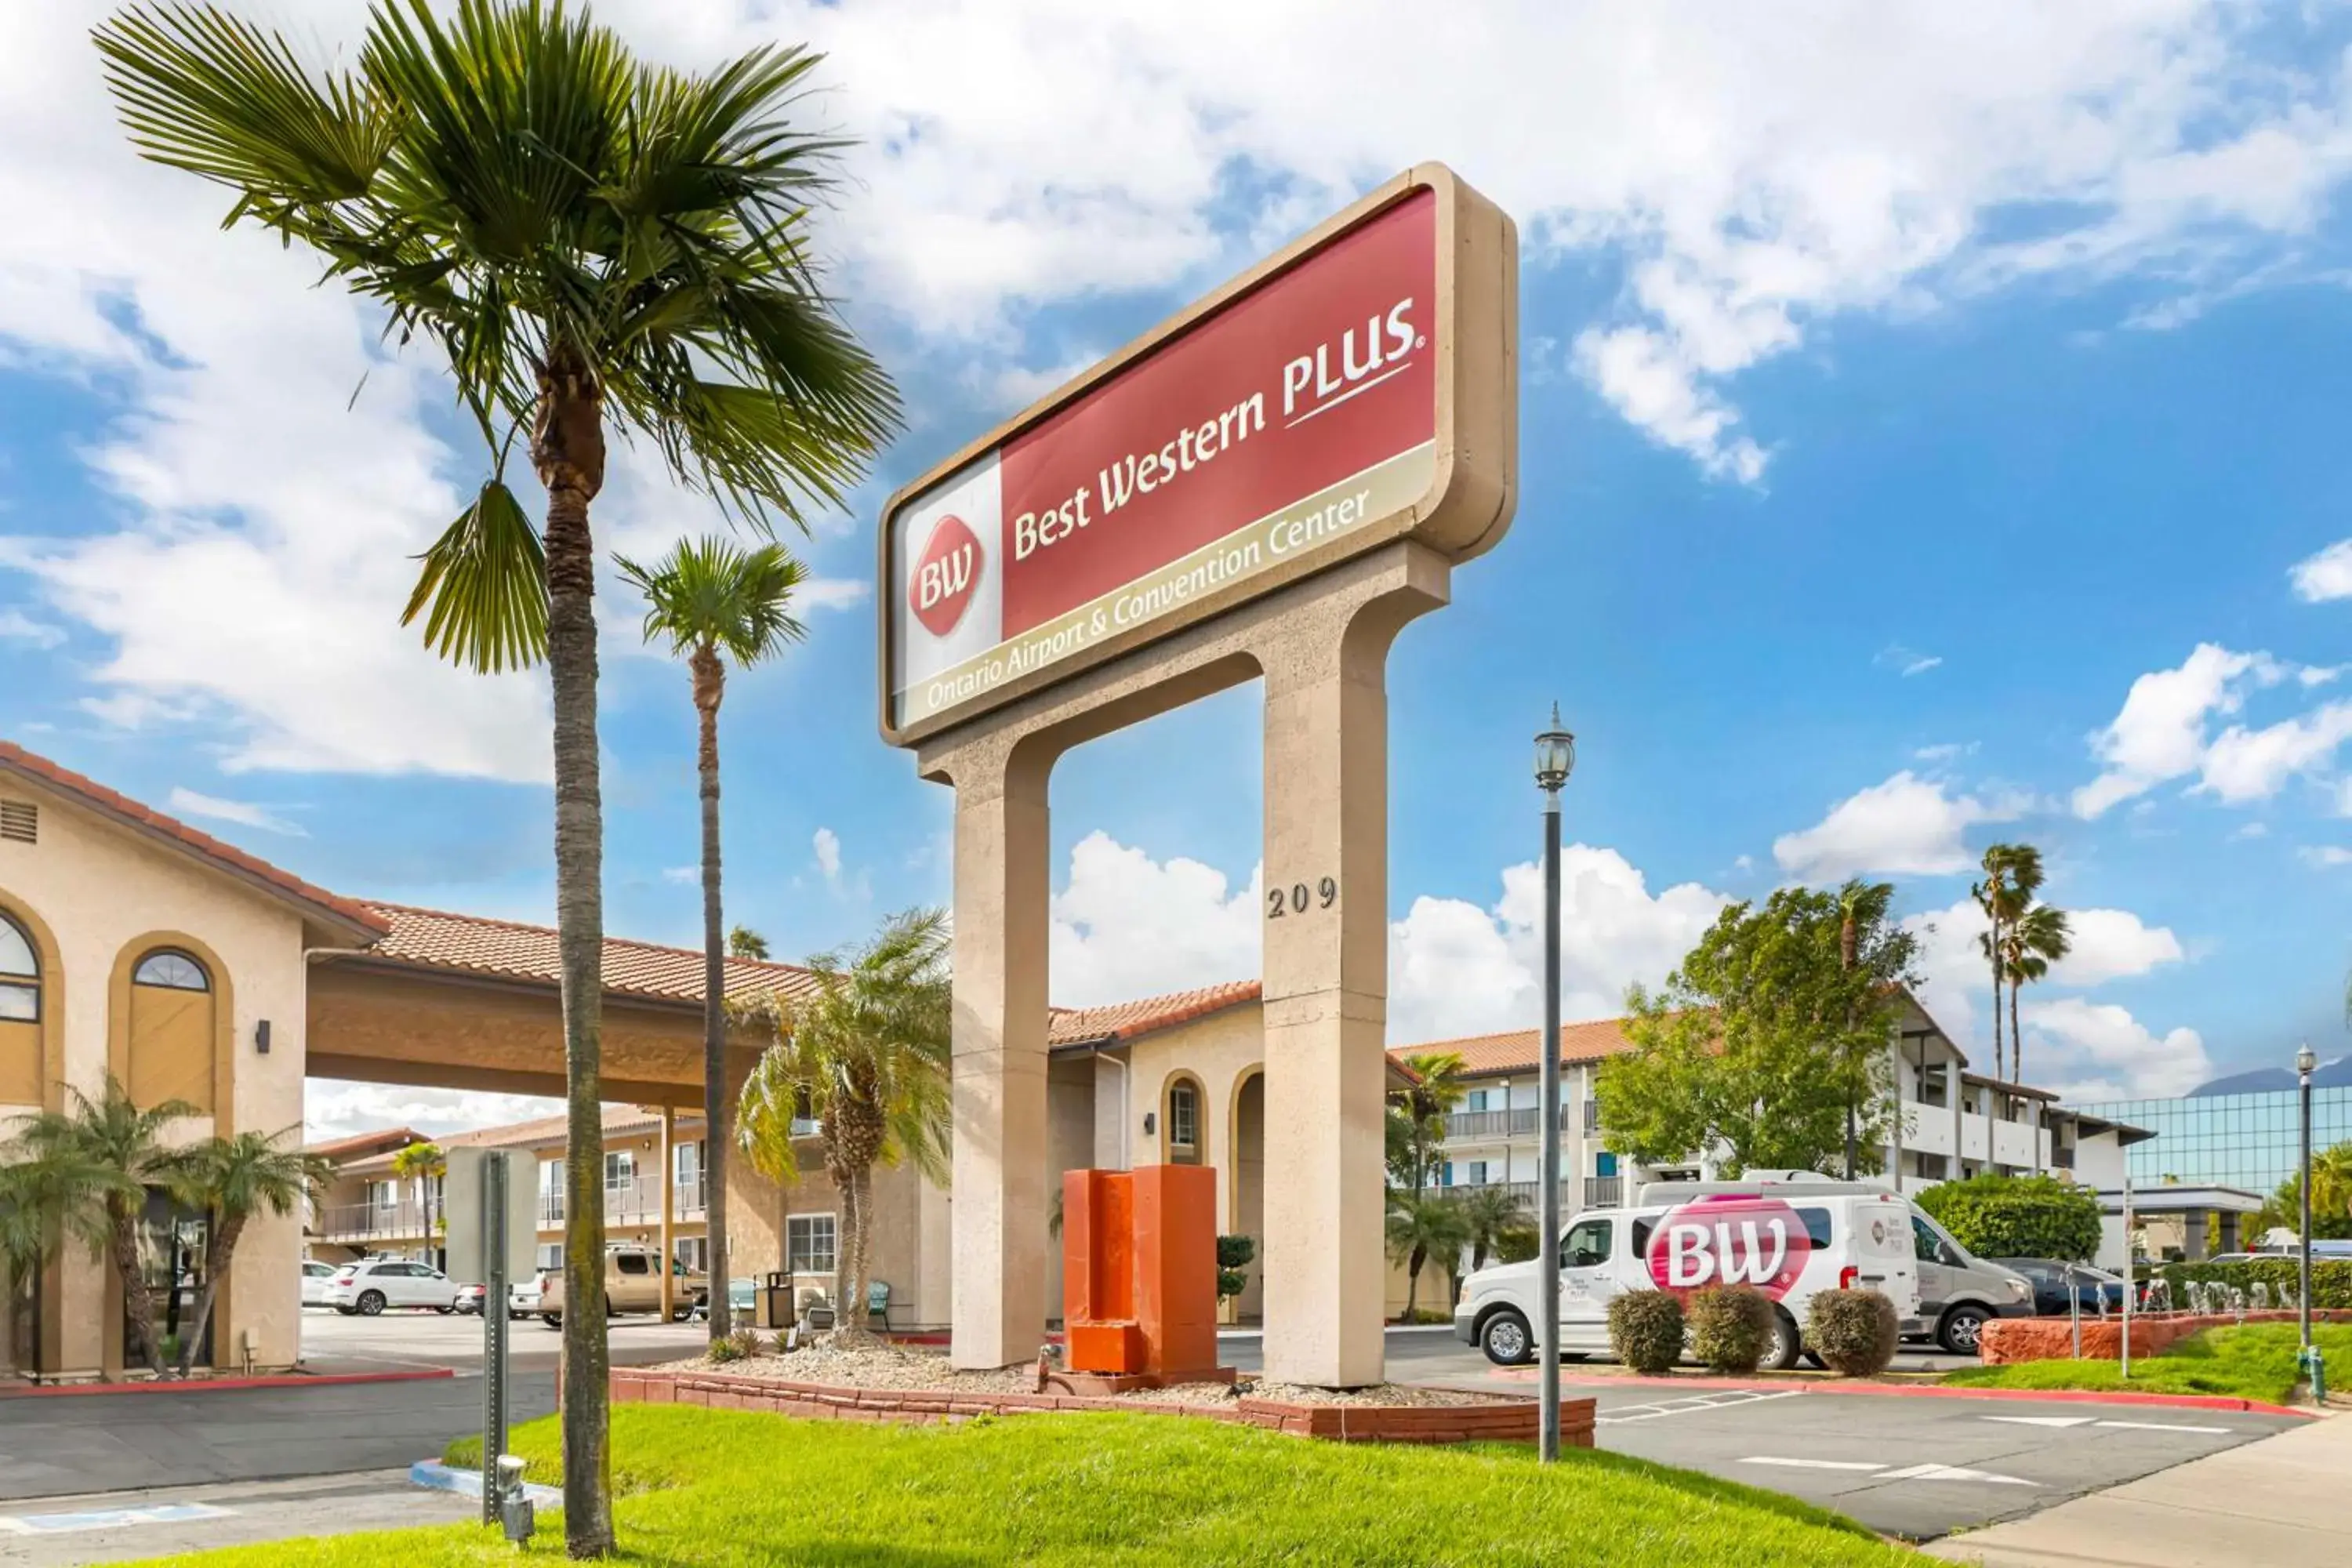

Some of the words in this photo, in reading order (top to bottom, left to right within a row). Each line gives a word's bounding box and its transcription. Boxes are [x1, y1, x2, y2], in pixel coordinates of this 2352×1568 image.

[1015, 486, 1091, 561] Best
[1098, 391, 1266, 515] Western
[919, 543, 973, 611] BW
[927, 657, 1003, 709] Ontario
[1007, 622, 1085, 670] Airport
[1090, 607, 1107, 637] &
[1113, 539, 1261, 626] Convention
[1269, 488, 1370, 555] Center
[1267, 876, 1337, 919] 209
[1668, 1218, 1787, 1287] BW
